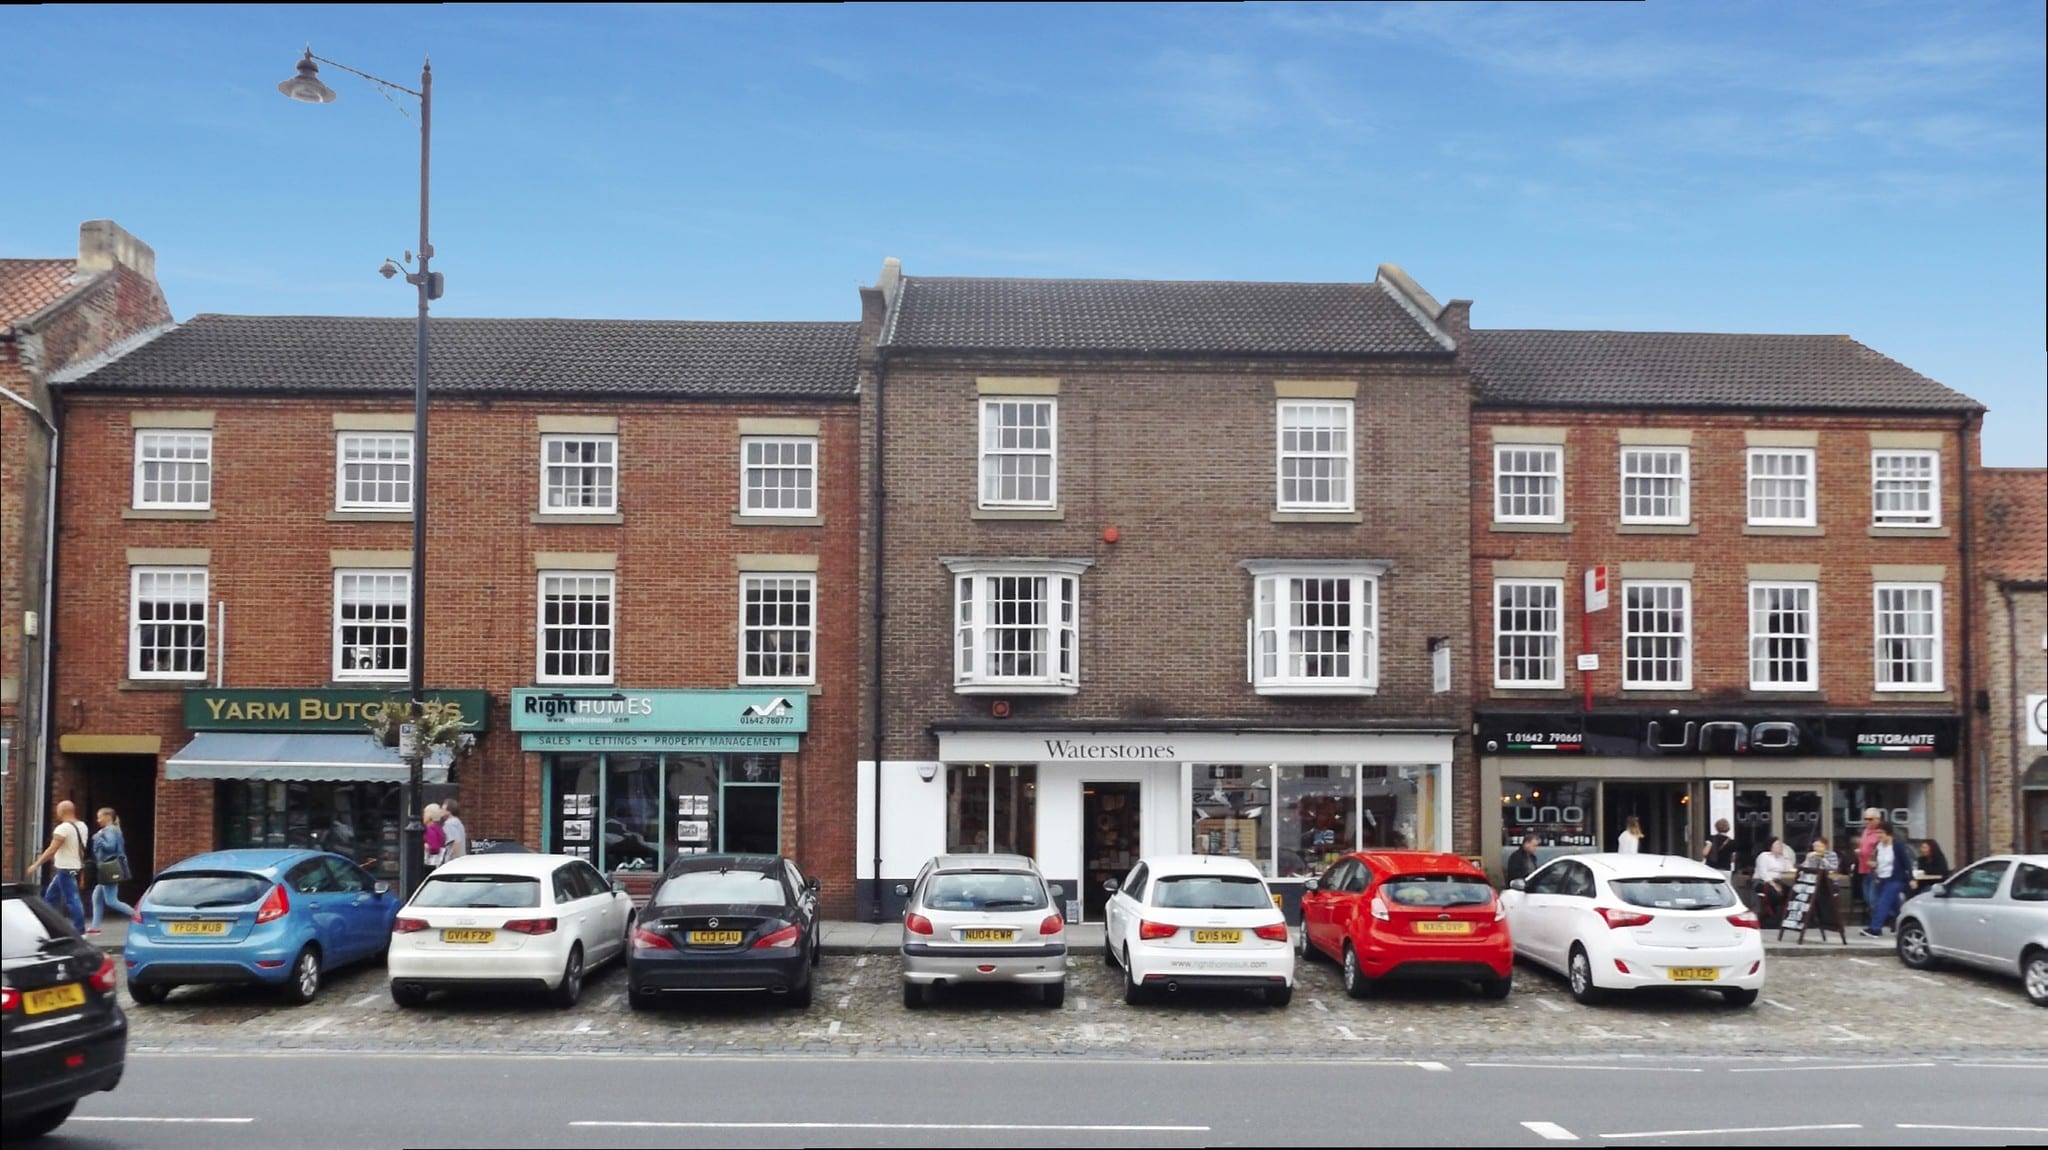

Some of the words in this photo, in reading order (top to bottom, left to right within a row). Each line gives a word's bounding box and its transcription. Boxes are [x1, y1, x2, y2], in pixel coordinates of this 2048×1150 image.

[206, 699, 290, 720] YARM
[300, 699, 463, 721] BUTCRS
[525, 695, 652, 717] RightHOMES
[740, 717, 764, 725] 01642
[766, 717, 794, 725] 780777
[539, 736, 571, 746] SALES
[588, 736, 638, 746] LETTINGS
[655, 736, 706, 746] PROPERTY
[710, 736, 783, 747] MANAGEMENT
[1507, 733, 1543, 743] T.01642
[1549, 733, 1582, 743] 790661
[1857, 734, 1935, 745] RISTORANTE
[1044, 740, 1175, 759] Waterstones
[447, 931, 469, 940] GV14
[472, 931, 492, 940] FZP
[693, 932, 716, 942] LC13
[718, 932, 739, 942] GAU
[966, 930, 990, 940] NU04
[993, 930, 1012, 940] EWR
[1197, 931, 1219, 940] GV15
[1222, 931, 1240, 940] HVJ
